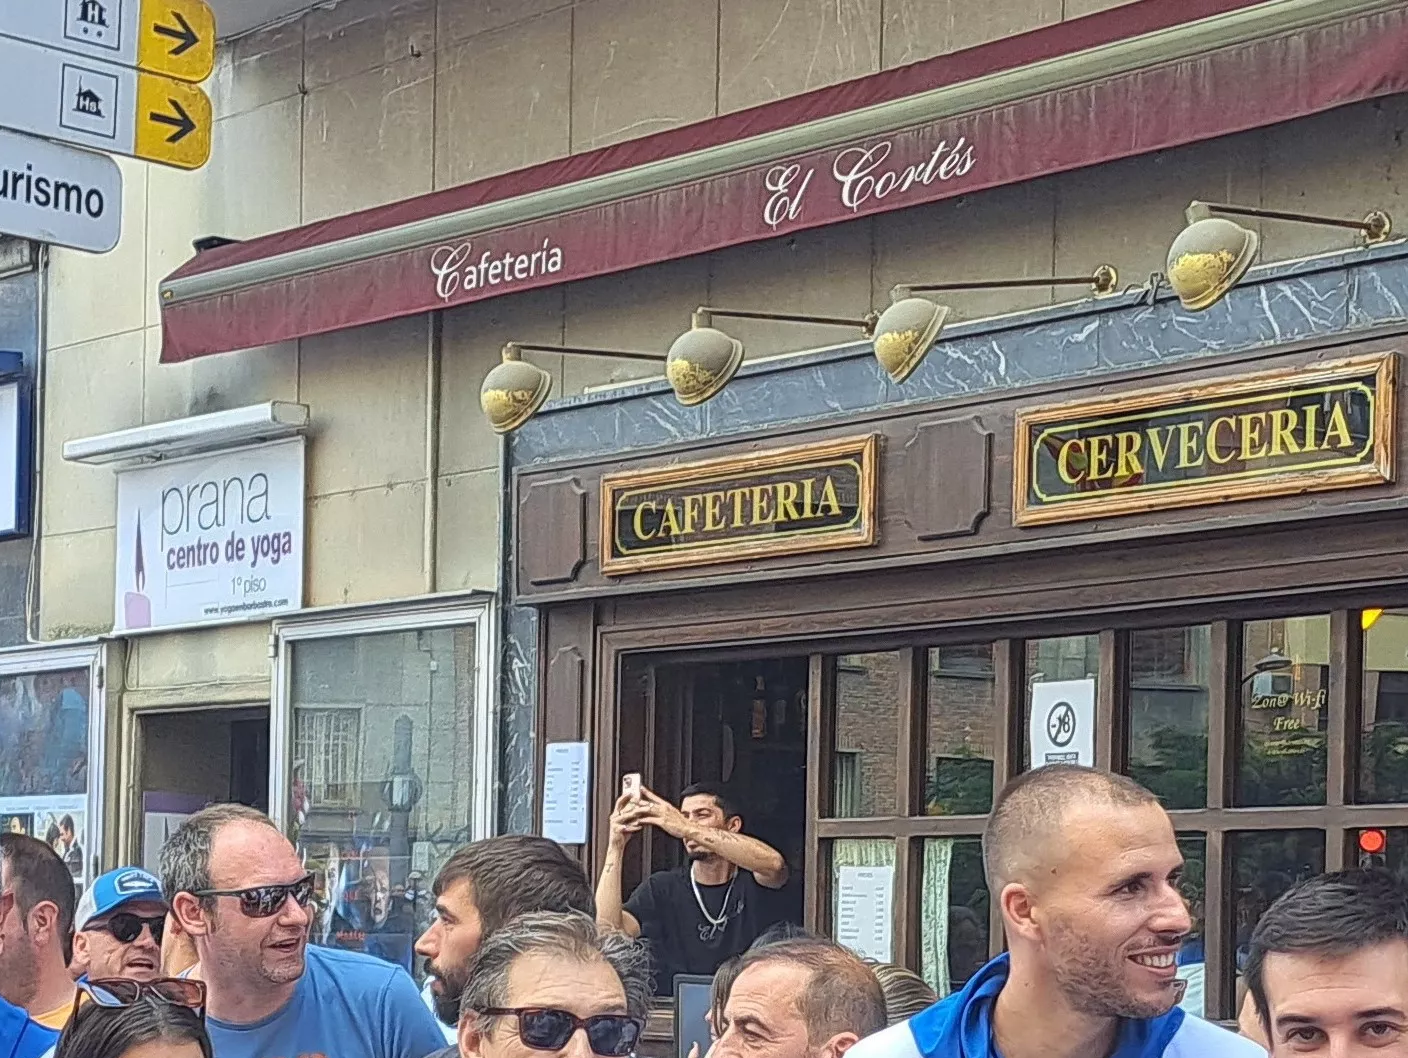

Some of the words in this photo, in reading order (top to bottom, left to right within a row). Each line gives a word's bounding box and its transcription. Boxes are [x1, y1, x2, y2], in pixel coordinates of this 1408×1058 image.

[764, 164, 815, 231] El
[832, 137, 978, 212] Cortés
[430, 238, 562, 302] Cafetería
[1057, 401, 1355, 486] CERVECERIA
[160, 473, 272, 552] prana
[631, 473, 843, 543] CAFETERIA
[166, 536, 220, 571] centro
[224, 530, 246, 563] de
[250, 530, 292, 568] yoga
[243, 574, 267, 598] piso
[1273, 716, 1300, 731] Free
